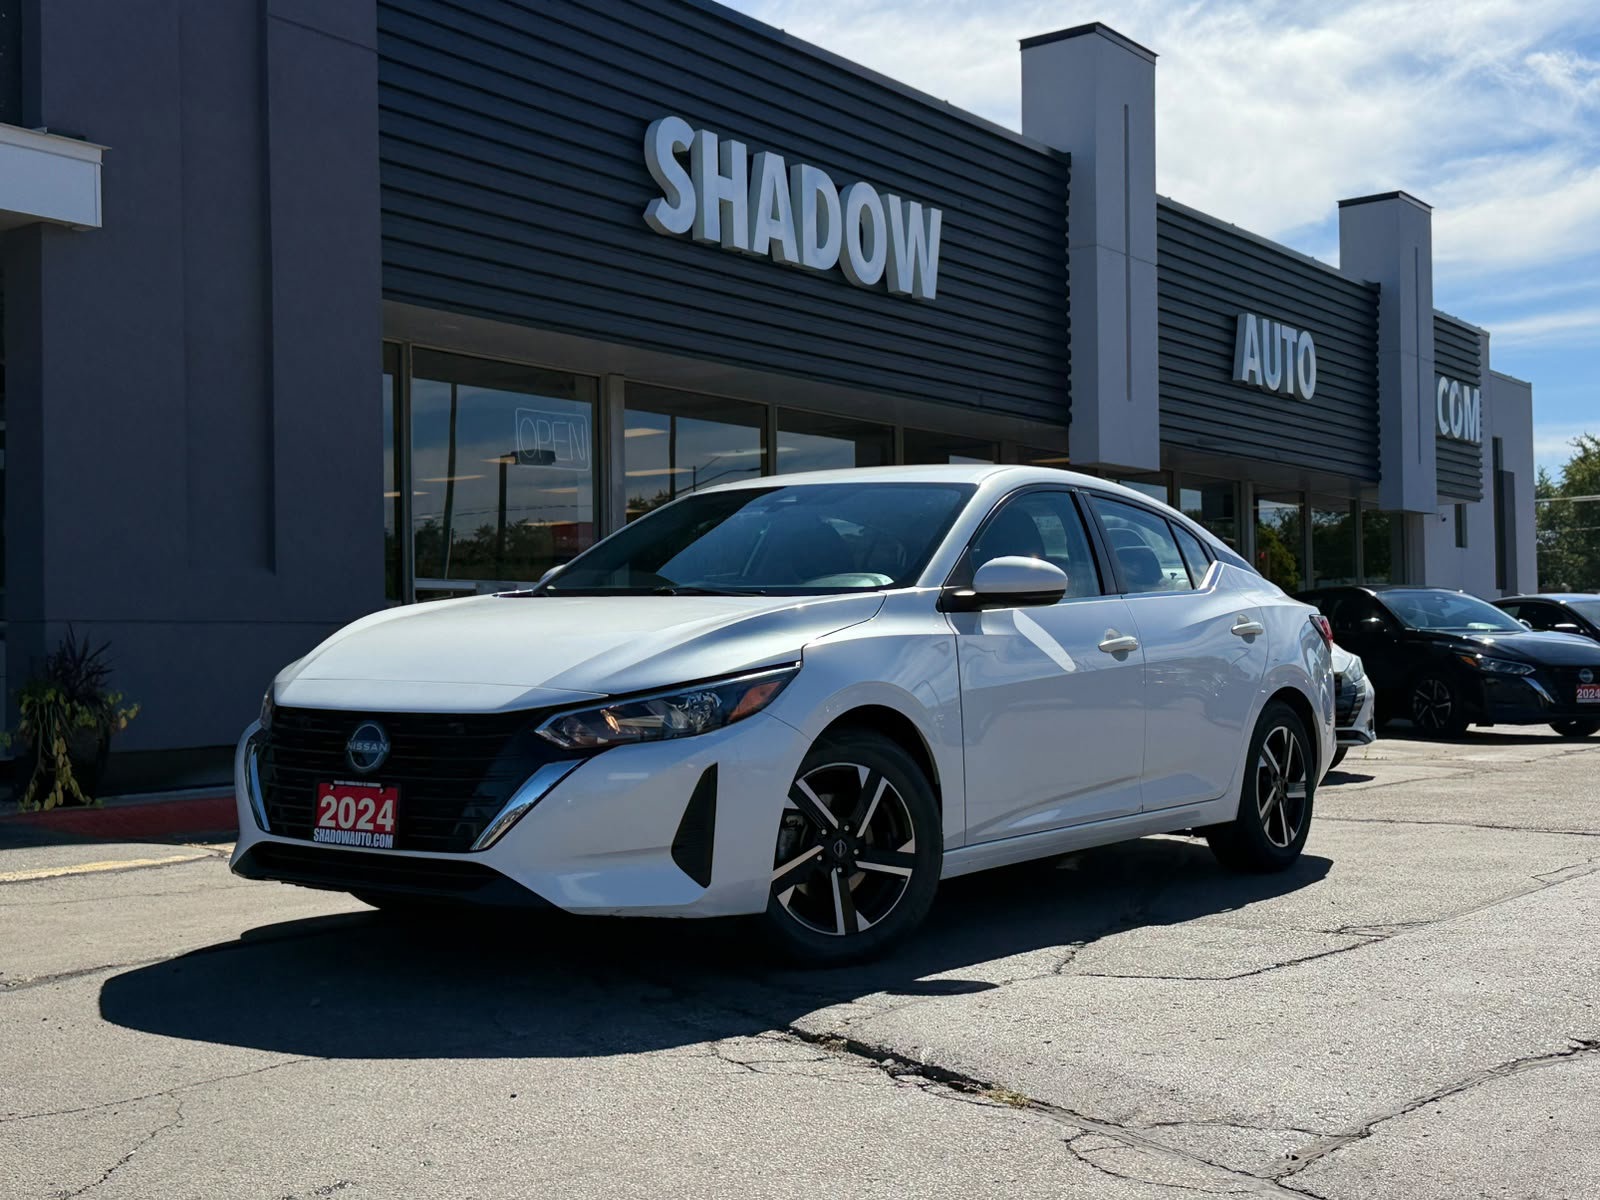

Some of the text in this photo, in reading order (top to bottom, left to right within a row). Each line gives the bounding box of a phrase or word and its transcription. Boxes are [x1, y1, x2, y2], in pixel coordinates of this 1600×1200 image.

[643, 115, 942, 300] SHADOW
[1233, 313, 1317, 400] AUTO
[1437, 376, 1480, 443] COM
[519, 416, 587, 461] OPEN
[1576, 688, 1600, 699] 2024
[346, 741, 388, 752] NISSAN
[319, 795, 394, 831] 2024
[313, 828, 393, 848] SHADOWAUTO.COM
